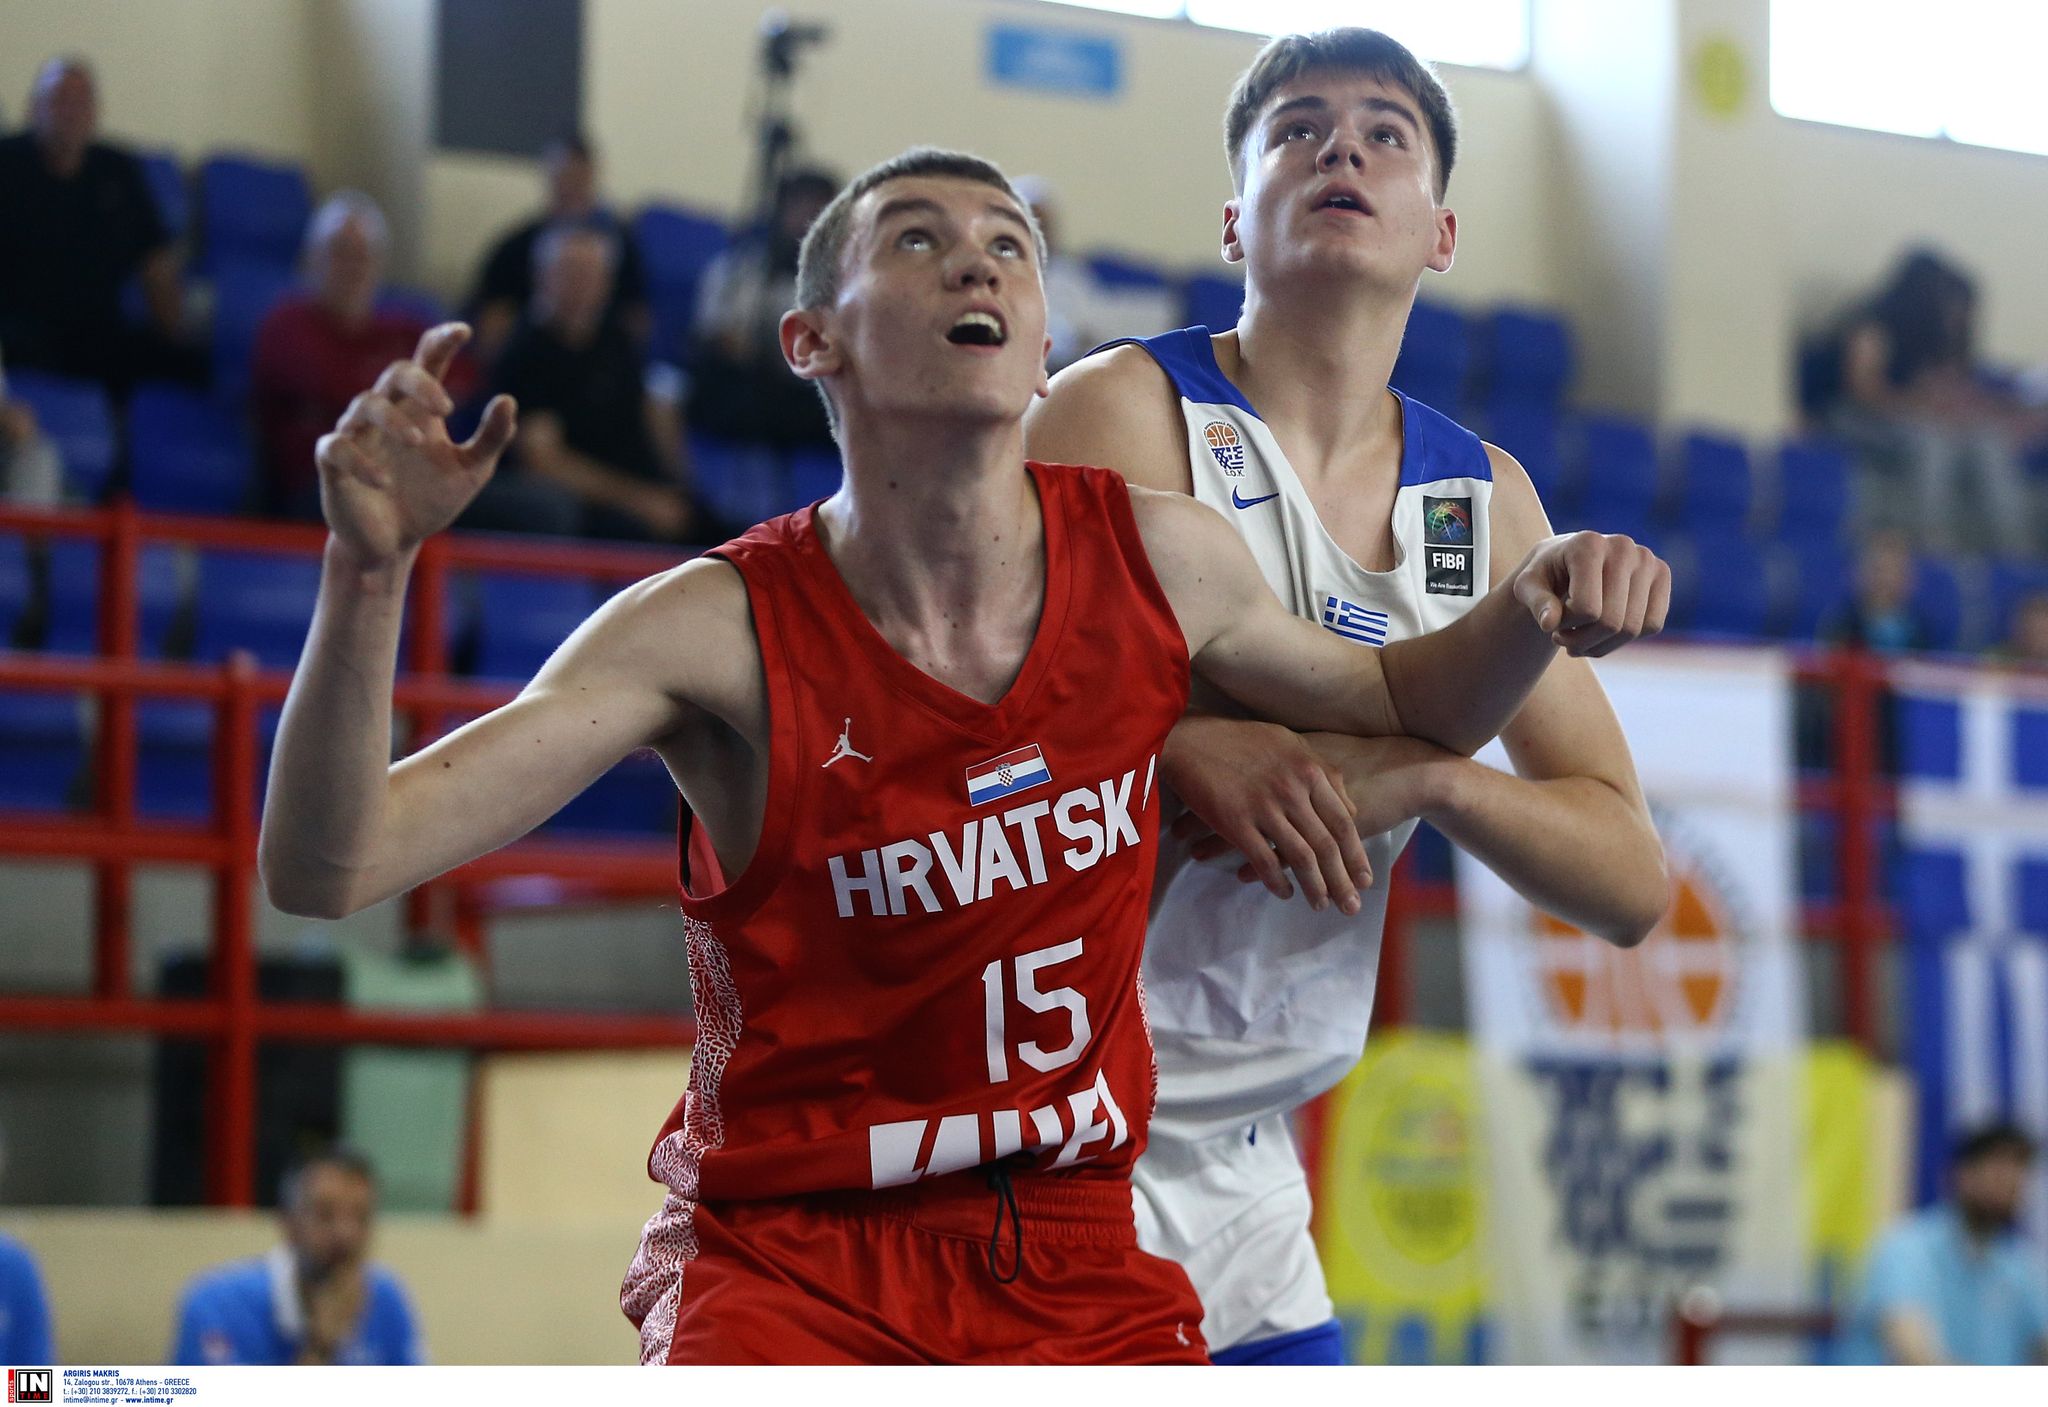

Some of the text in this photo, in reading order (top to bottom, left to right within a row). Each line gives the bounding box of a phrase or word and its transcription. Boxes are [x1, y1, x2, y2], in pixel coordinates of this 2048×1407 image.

[1432, 552, 1465, 571] FIBA
[828, 753, 1156, 918] HRVATSK
[981, 937, 1092, 1084] 15
